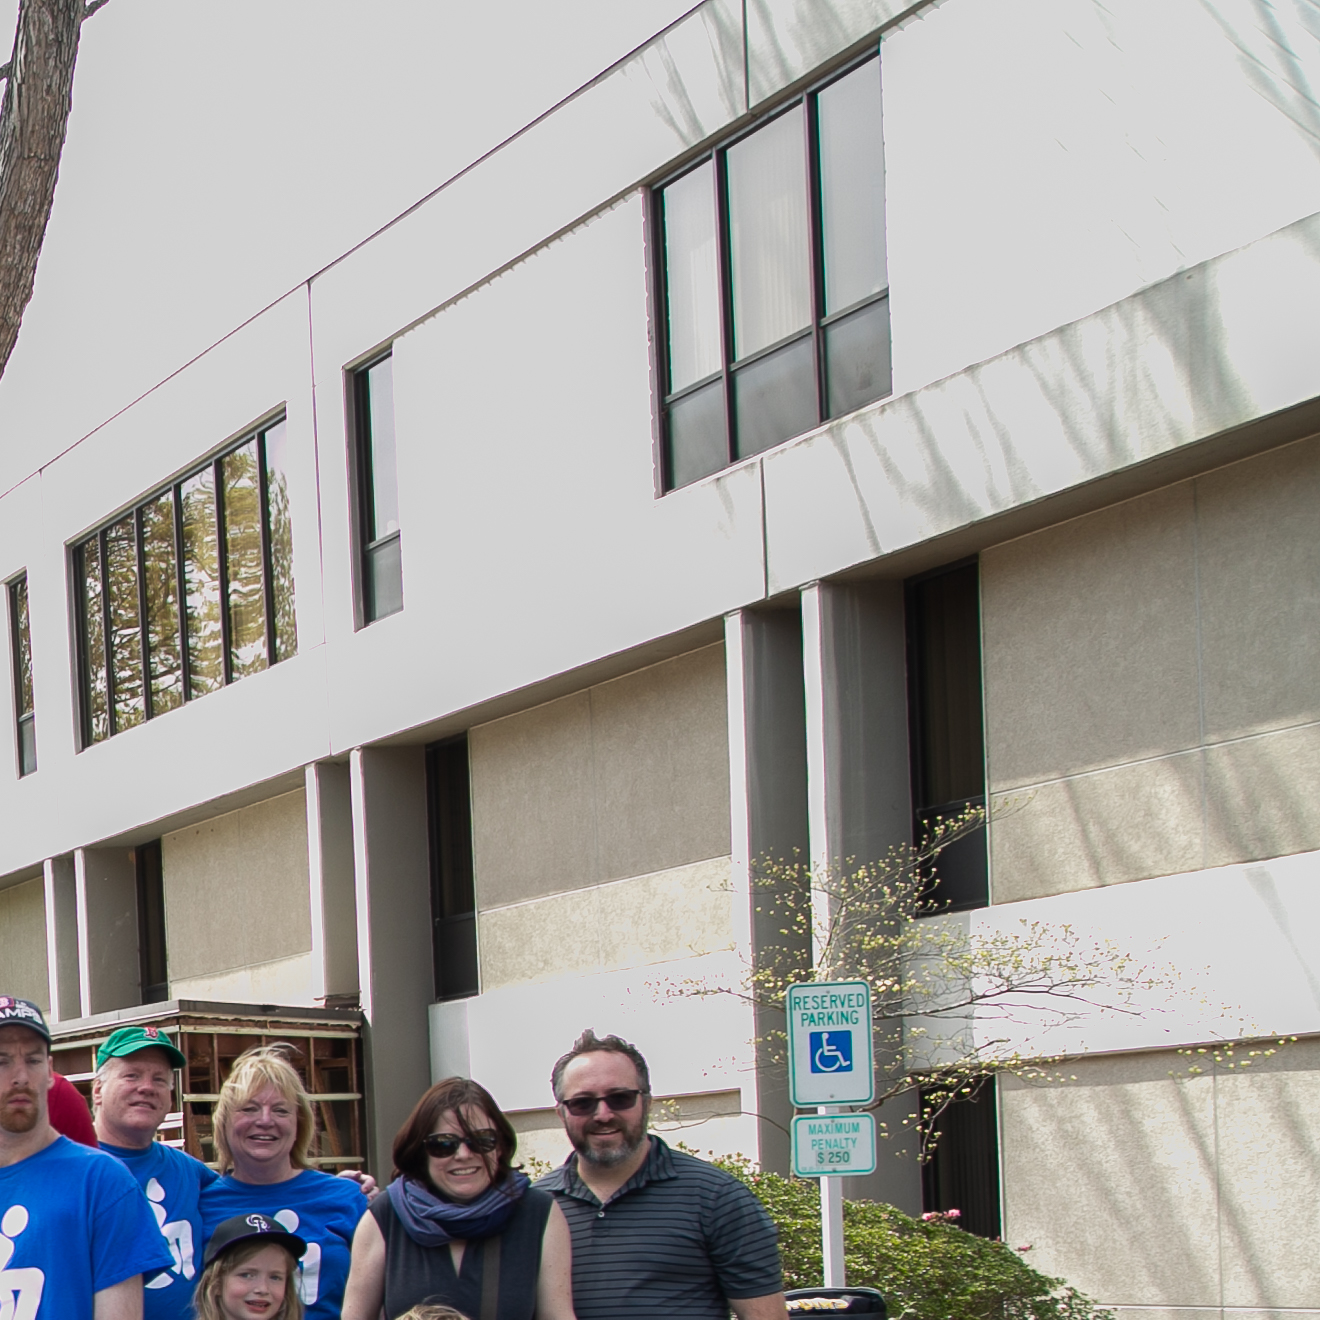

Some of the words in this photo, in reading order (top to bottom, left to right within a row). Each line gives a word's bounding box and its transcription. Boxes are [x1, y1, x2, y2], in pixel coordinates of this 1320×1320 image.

[793, 993, 865, 1011] RESERVED
[801, 1010, 859, 1028] PARKING
[809, 1122, 860, 1136] MAXIMUM
[811, 1137, 857, 1151] PENALTY
